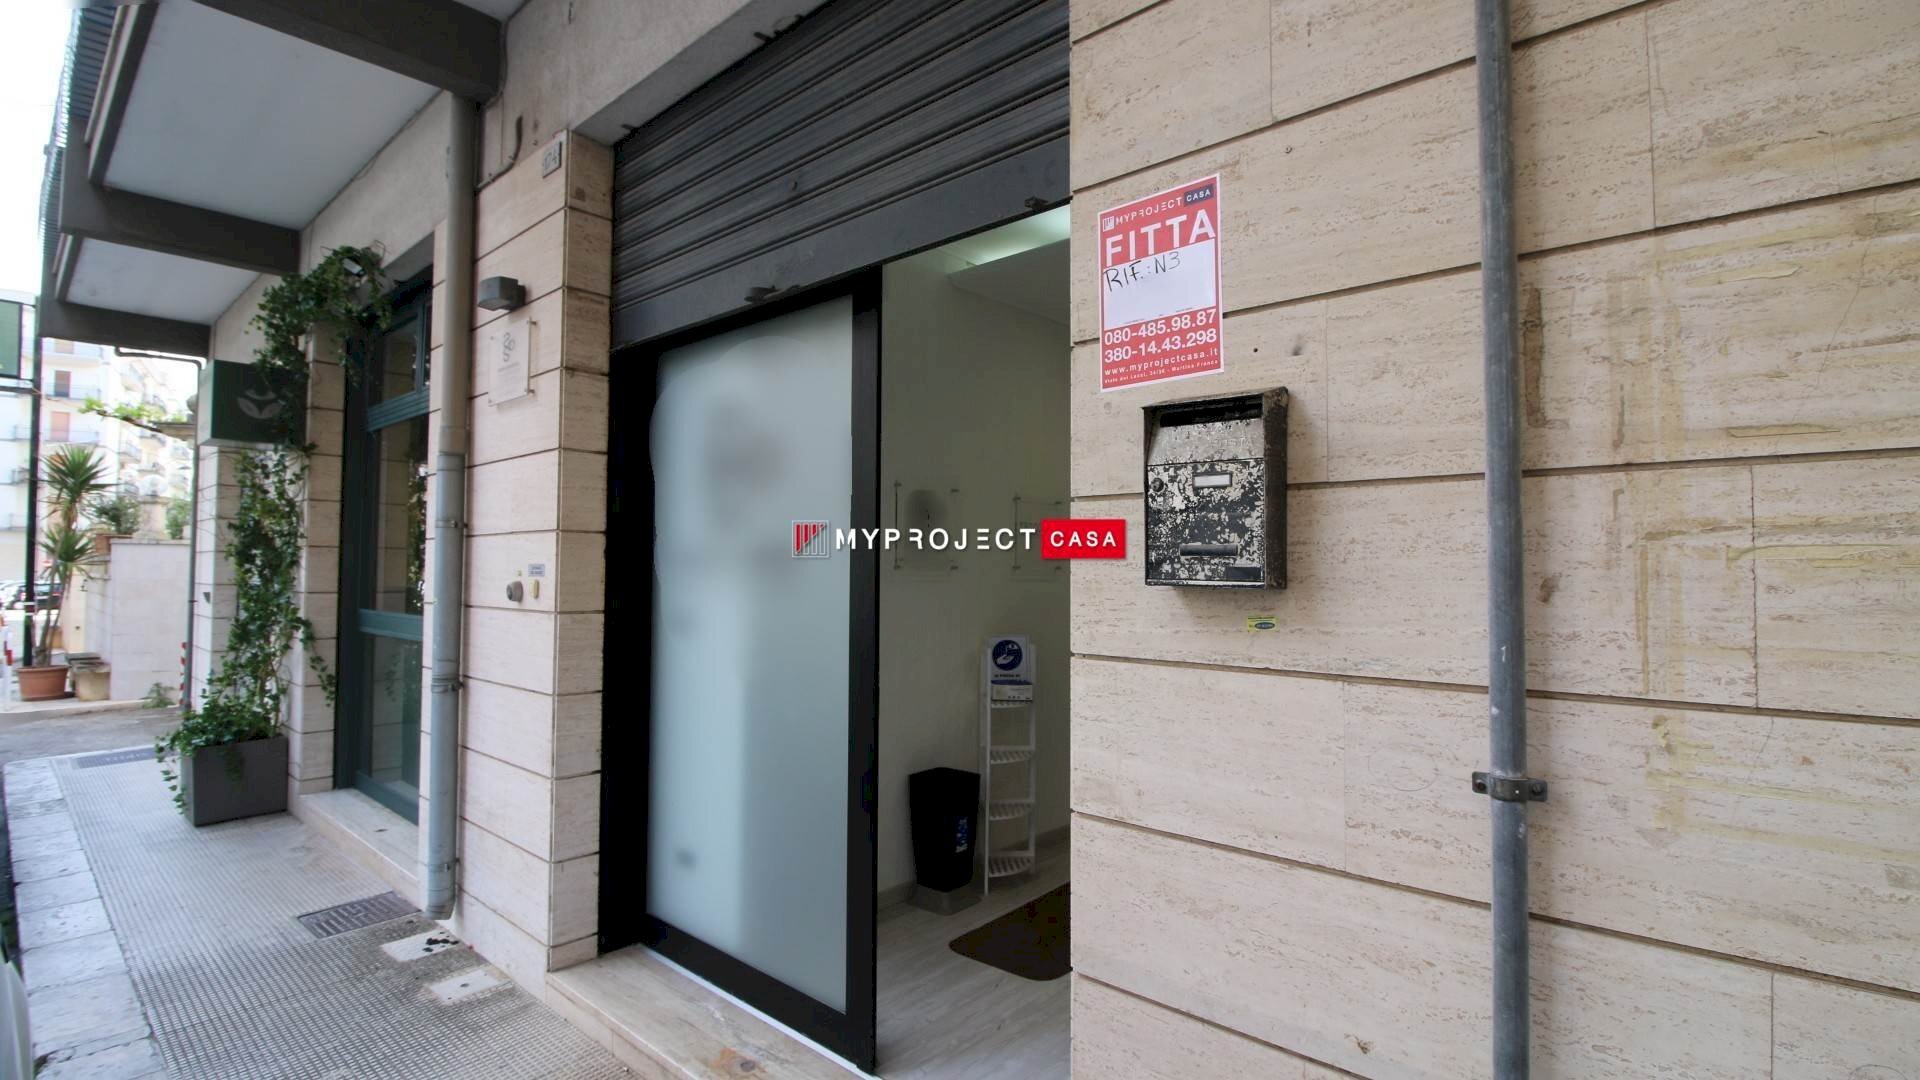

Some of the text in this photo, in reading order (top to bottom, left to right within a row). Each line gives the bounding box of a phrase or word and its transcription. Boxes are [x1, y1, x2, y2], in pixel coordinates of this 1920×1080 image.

[1115, 188, 1211, 225] MYPROJECT CASA
[1105, 209, 1216, 268] FITTA
[1104, 308, 1217, 346] 080-485.98.87
[1104, 327, 1217, 363] 380-14.43.298
[1104, 347, 1218, 376] www.myprojectcasa.it
